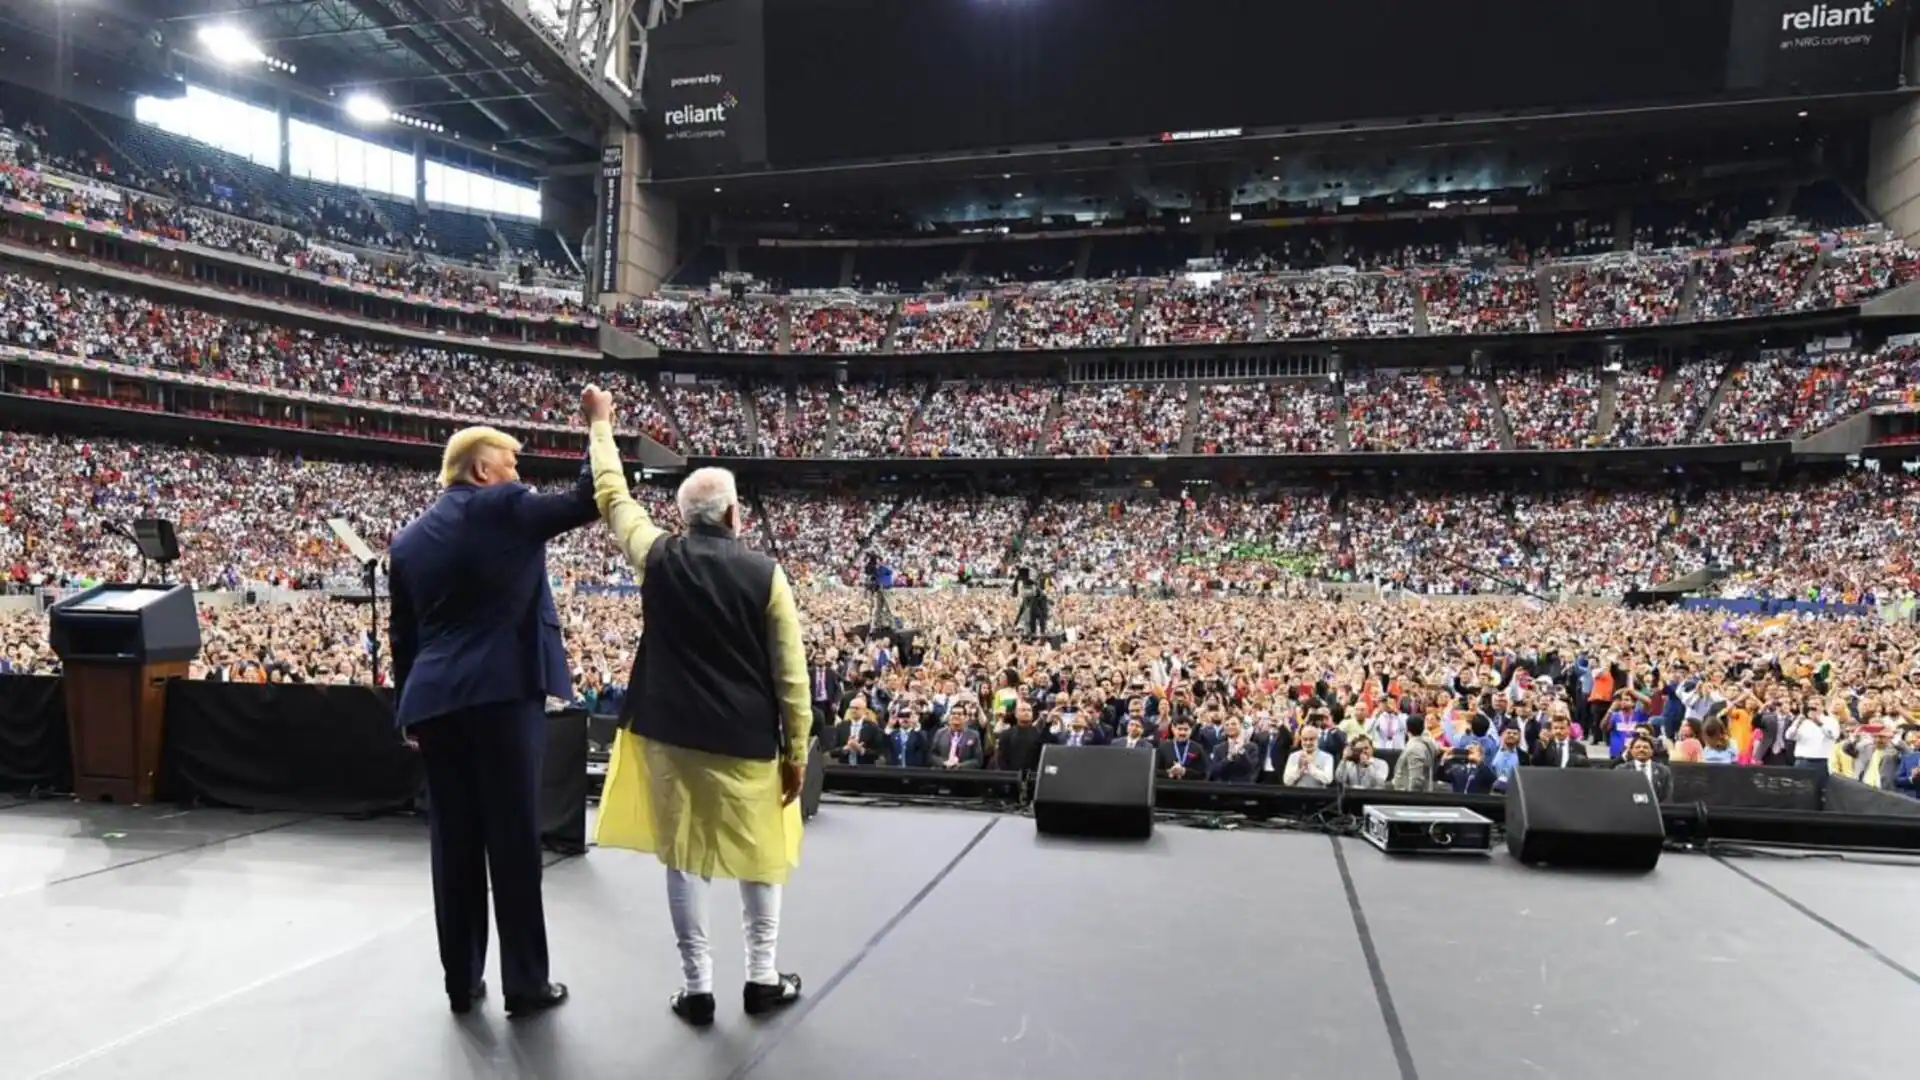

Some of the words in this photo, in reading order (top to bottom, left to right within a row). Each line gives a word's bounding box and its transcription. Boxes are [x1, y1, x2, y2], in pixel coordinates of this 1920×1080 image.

[1782, 1, 1875, 30] reliant
[710, 73, 722, 87] by
[665, 103, 727, 125] reliant
